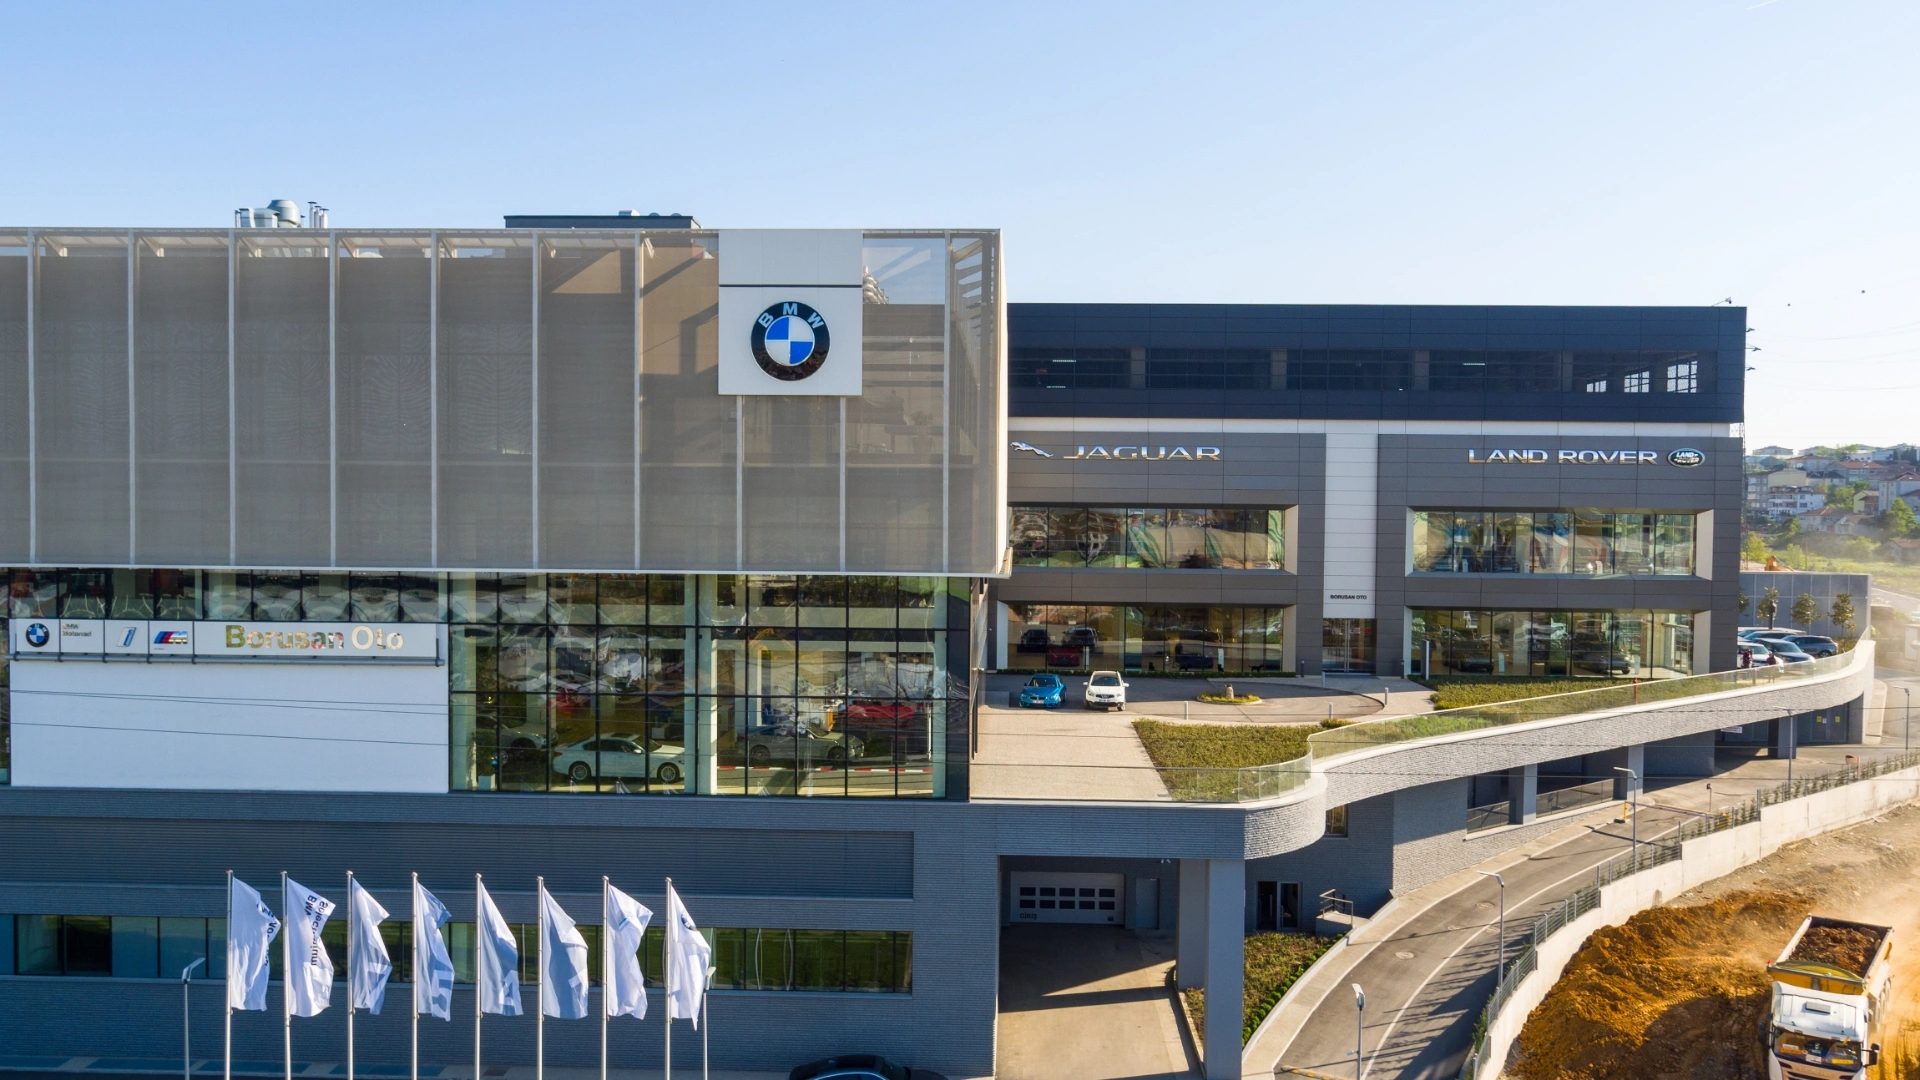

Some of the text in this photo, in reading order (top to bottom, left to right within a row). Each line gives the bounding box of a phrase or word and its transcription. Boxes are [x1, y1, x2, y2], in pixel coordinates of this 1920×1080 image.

[758, 302, 825, 329] BMW
[1063, 445, 1221, 461] JAGUAR
[1468, 449, 1658, 466] LAND ROVER
[225, 624, 404, 650] Borusan Oto
[1019, 912, 1038, 920] GİRİŞ
